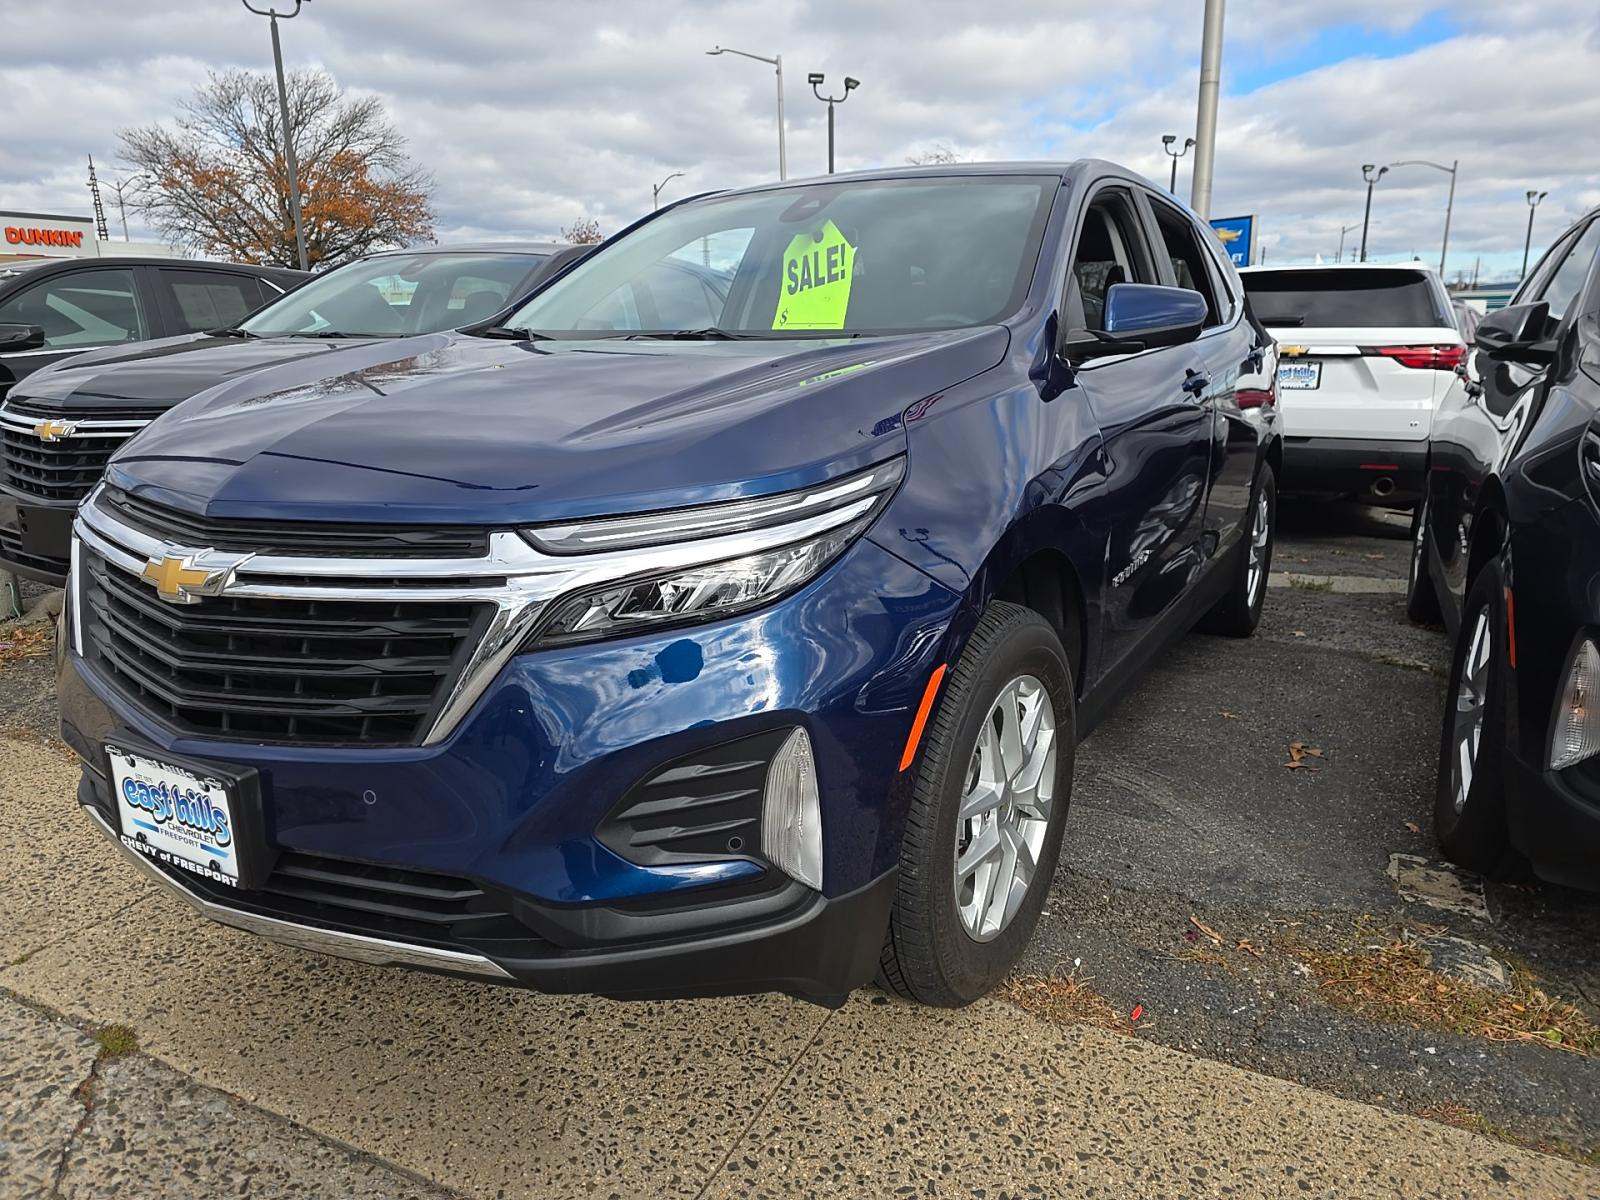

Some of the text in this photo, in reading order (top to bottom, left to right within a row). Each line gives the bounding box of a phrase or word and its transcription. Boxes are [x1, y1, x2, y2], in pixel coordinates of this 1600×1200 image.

[5, 226, 83, 248] DUNKIN'
[787, 243, 846, 296] SALE!
[123, 777, 231, 847] east hills
[160, 828, 199, 847] FREEPORT
[167, 822, 214, 844] CHEVROLET
[120, 835, 157, 857] CHEVY
[172, 856, 238, 888] FREEPORT
